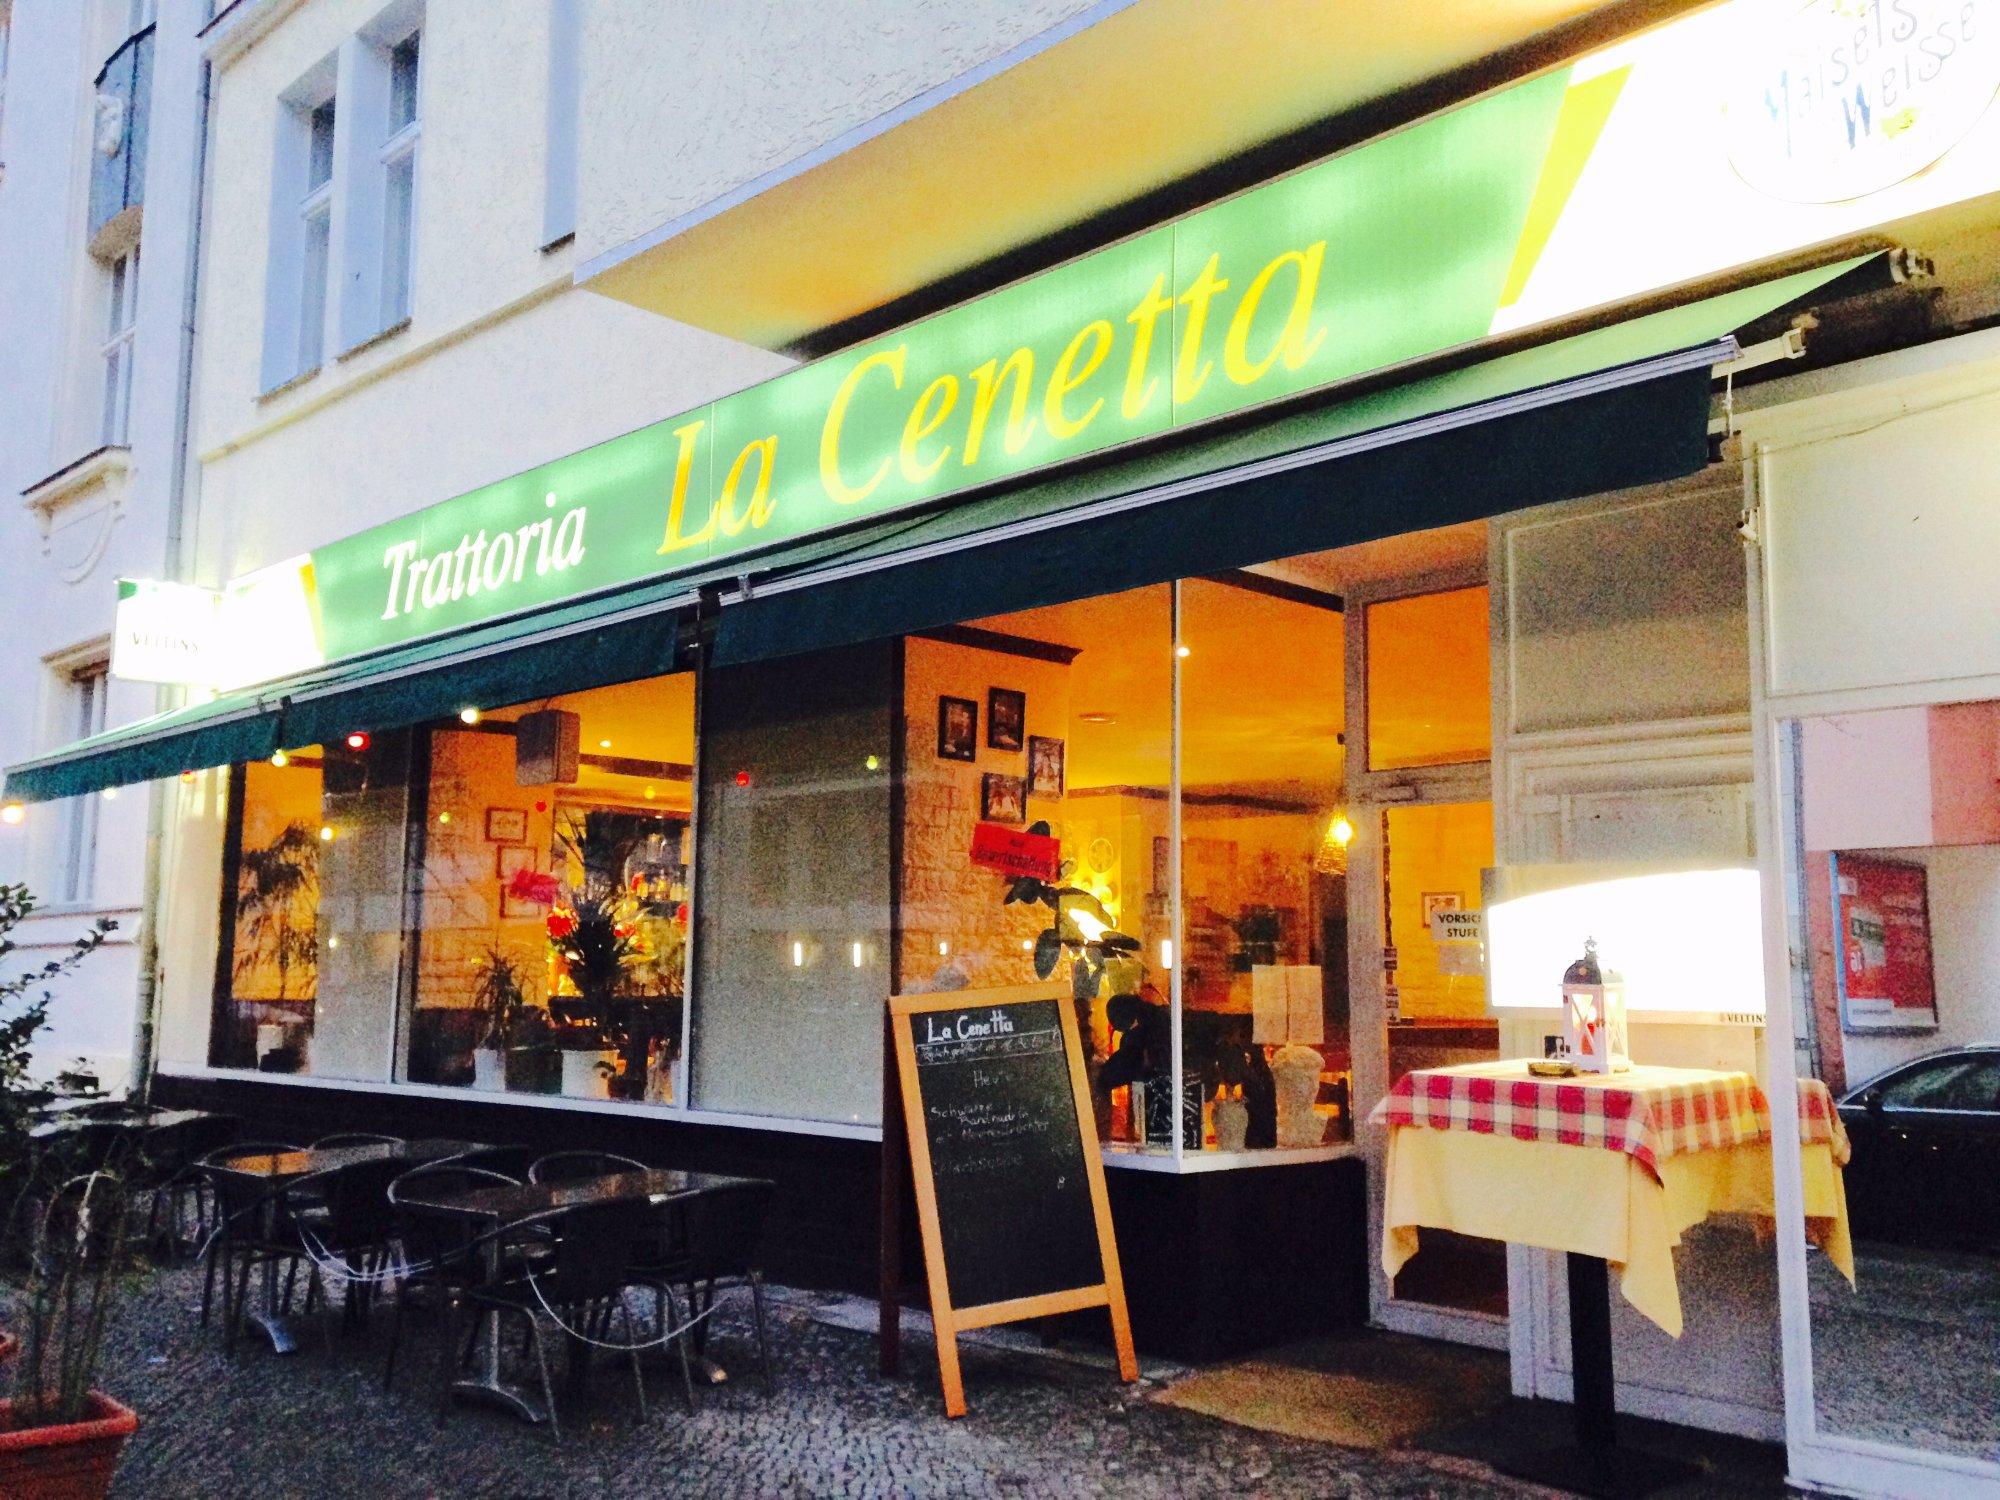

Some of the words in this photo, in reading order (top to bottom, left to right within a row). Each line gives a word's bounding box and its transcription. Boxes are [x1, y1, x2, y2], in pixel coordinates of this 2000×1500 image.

[381, 491, 588, 621] Trattoria
[656, 419, 779, 555] La
[818, 240, 1328, 504] Cenetta
[1446, 927, 1479, 938] STUFE
[927, 1016, 952, 1043] La
[956, 1009, 1015, 1040] Cenetta
